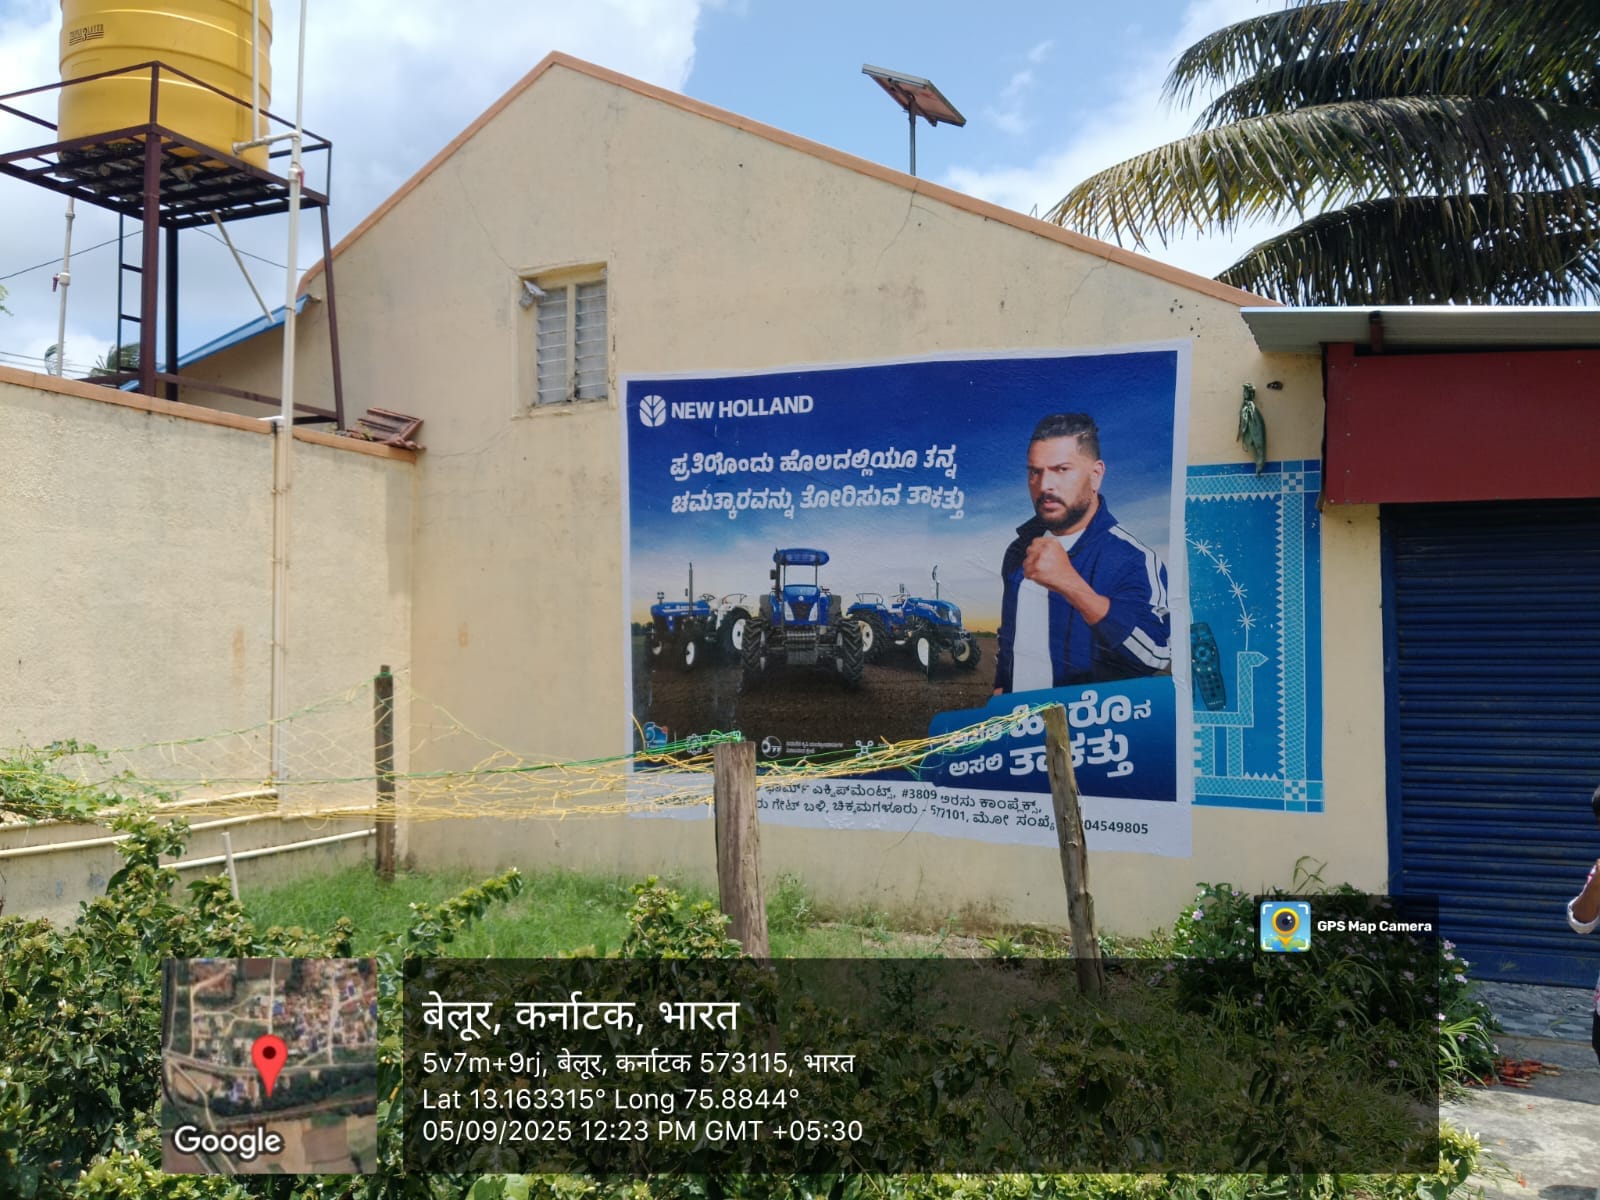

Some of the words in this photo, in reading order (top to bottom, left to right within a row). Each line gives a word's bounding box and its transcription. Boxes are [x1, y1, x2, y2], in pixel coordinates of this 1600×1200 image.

[671, 401, 715, 420] NEW
[718, 395, 814, 418] HOLLAND
[670, 451, 774, 481] ಪ್ರತಿಯೊಂದು
[780, 446, 918, 477] ಹೊಲದಲ್ಲಿಯೂ
[923, 444, 957, 479] ತನ್ನ
[671, 487, 795, 520] ಚಮತ್ಕಾರವನ್ನು
[800, 483, 902, 509] ತೋರಿಸುವ
[906, 485, 965, 520] ತಾಕತ್ತು
[949, 753, 1003, 776] ಅಸಲಿ
[902, 789, 938, 800] #3809
[1081, 819, 1149, 834] 04549805
